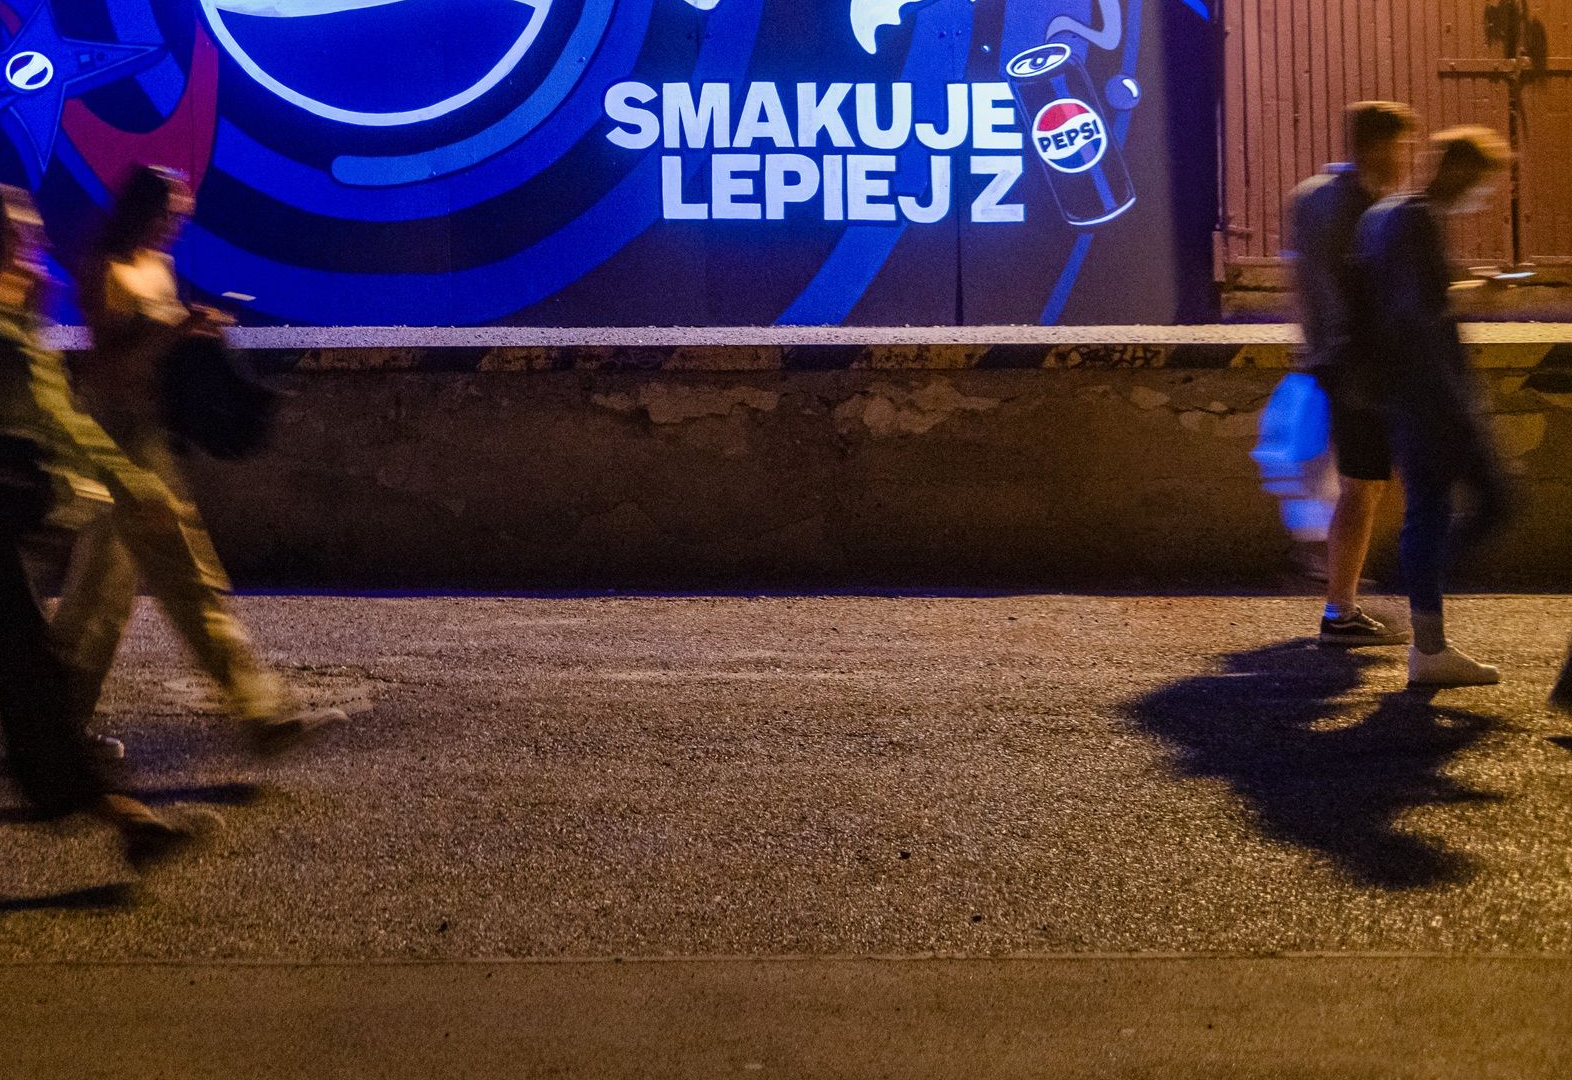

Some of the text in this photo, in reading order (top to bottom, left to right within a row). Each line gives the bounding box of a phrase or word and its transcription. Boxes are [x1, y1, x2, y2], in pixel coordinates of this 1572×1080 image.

[604, 82, 1023, 149] SMAKUJE
[1037, 119, 1100, 153] PEPSI
[661, 154, 1025, 223] LEPIEJ Z
